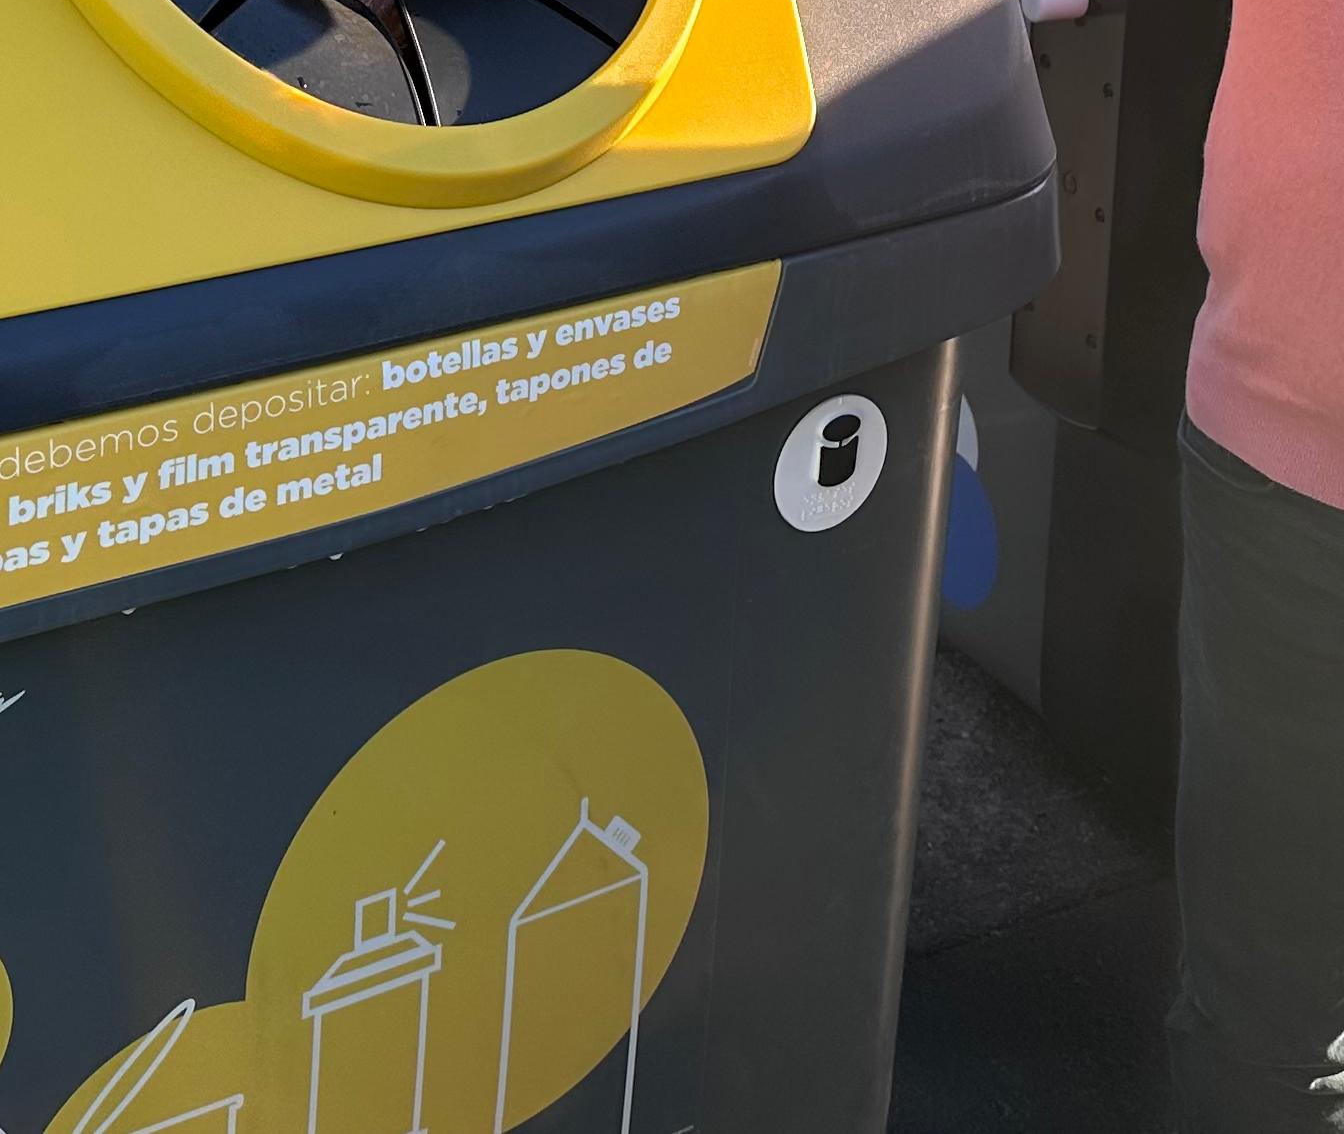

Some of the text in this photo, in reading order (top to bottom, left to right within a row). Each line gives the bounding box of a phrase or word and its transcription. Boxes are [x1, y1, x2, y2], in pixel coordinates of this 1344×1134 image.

[8, 478, 113, 526] briks
[122, 471, 149, 505] y
[158, 445, 235, 490] film
[244, 390, 488, 469] transparente,
[494, 350, 627, 407] tapones
[632, 338, 673, 370] de
[192, 371, 371, 435] depositar:
[381, 333, 519, 391] botellas
[525, 328, 547, 359] y
[555, 295, 682, 346] envases
[60, 530, 88, 564] y
[97, 497, 209, 548] tapas
[218, 486, 266, 519] de
[276, 453, 383, 506] metal
